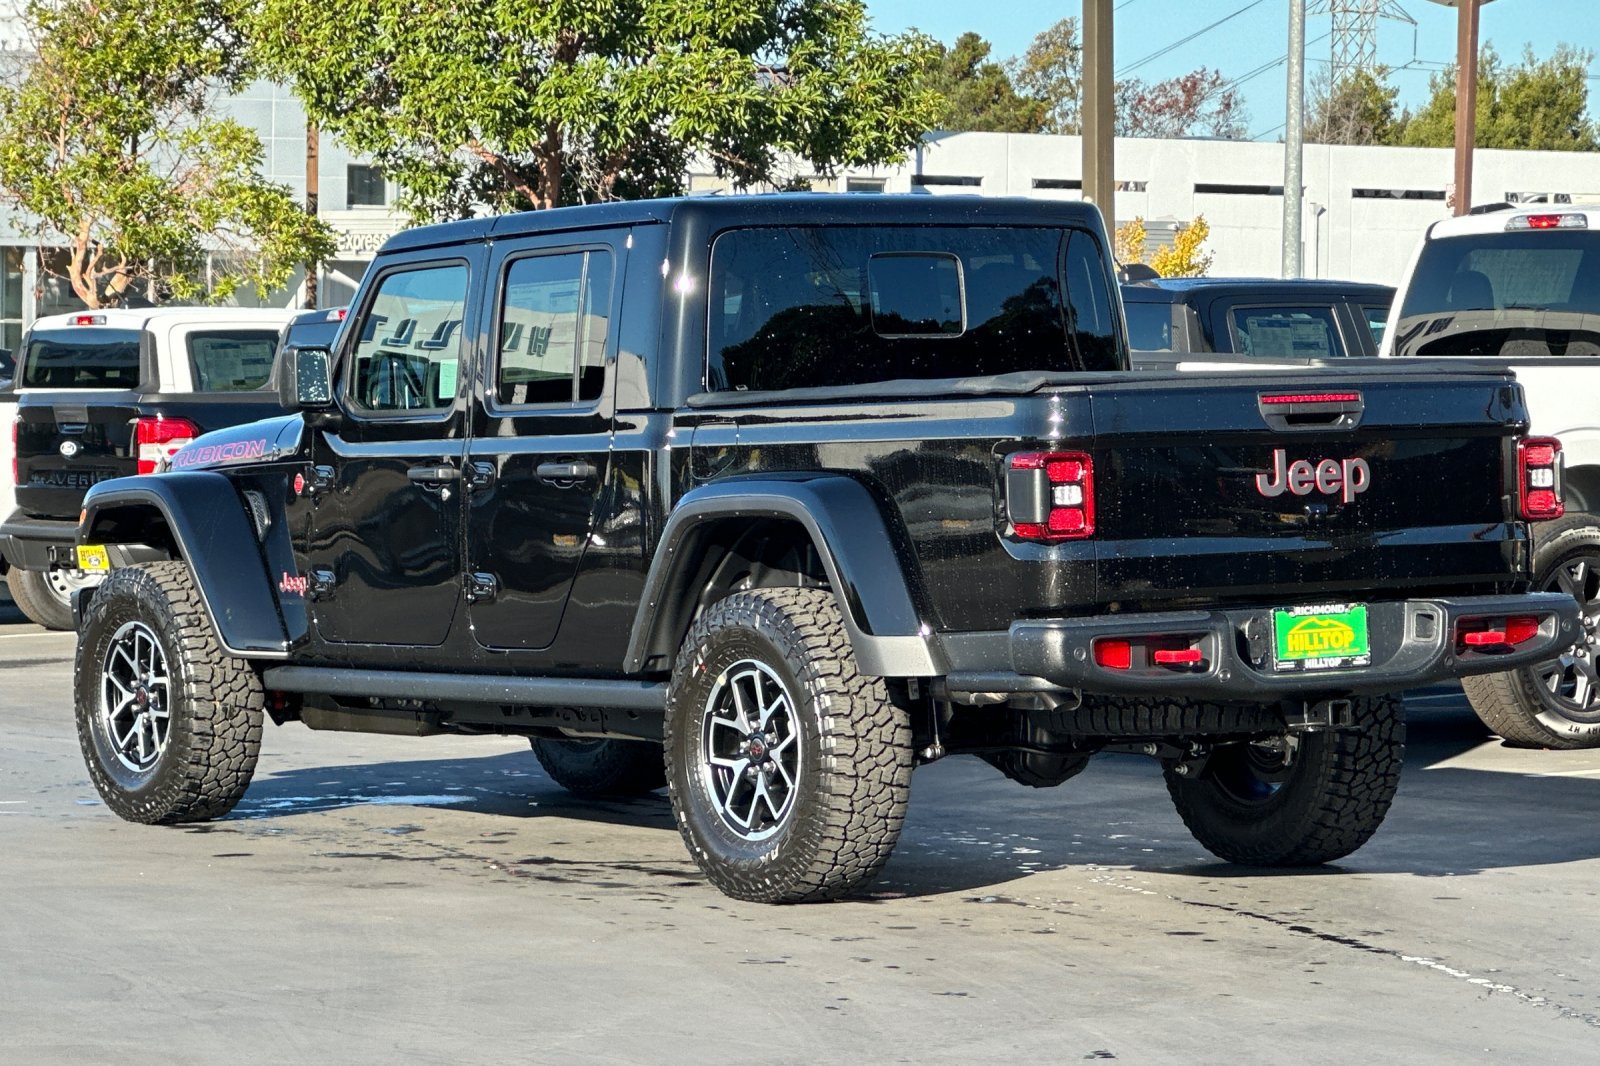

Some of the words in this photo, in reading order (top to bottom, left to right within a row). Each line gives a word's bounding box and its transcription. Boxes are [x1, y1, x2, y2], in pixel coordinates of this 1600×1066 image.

[172, 438, 266, 468] RUBICON
[1255, 448, 1371, 503] Jeep
[279, 571, 307, 597] Jeep
[1293, 604, 1346, 615] RICHMOND
[1287, 630, 1355, 652] HILLTOP
[1304, 657, 1342, 668] HILLTOP
